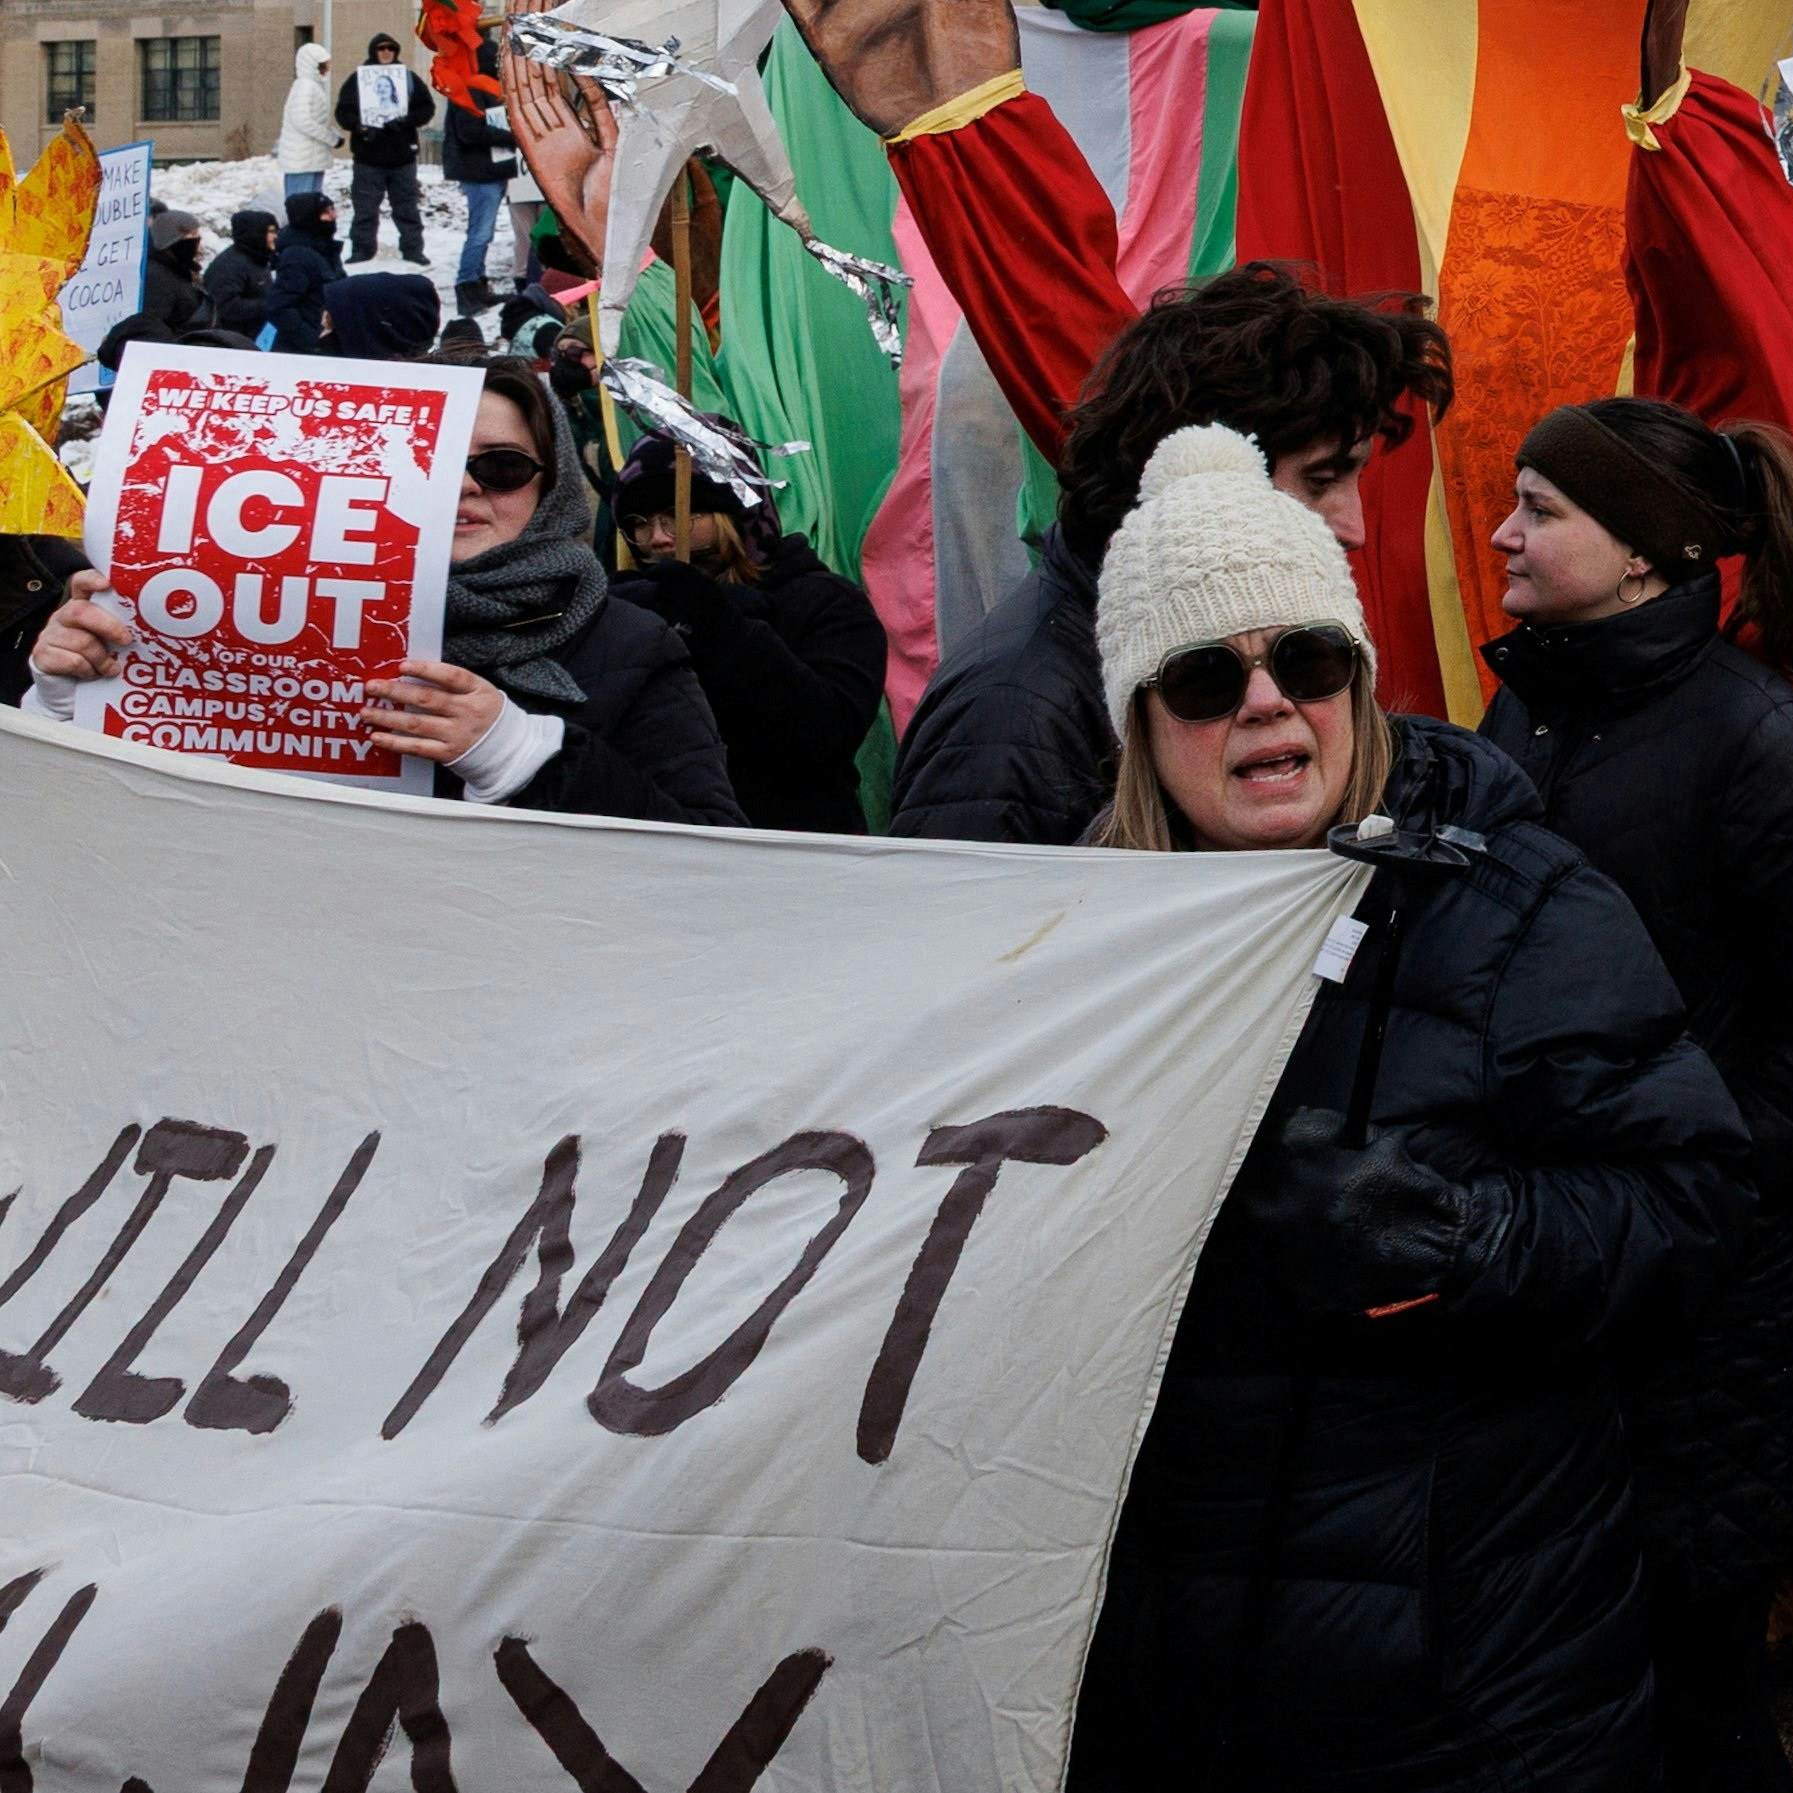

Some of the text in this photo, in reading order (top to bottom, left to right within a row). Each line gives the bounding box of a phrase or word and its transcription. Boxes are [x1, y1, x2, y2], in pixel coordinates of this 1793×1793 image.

[102, 160, 141, 192] MAKE
[97, 236, 134, 266] GET
[68, 279, 124, 311] COCOA
[156, 388, 206, 408] WE
[210, 393, 290, 416] KEEP
[291, 396, 333, 419] US
[156, 465, 390, 565] ICE
[137, 567, 387, 651] OUT
[218, 650, 297, 670] OF OUR
[122, 693, 277, 726] CAMPUS,
[121, 723, 376, 763] COMMUNITY
[0, 1103, 1110, 1466] ILL NOT
